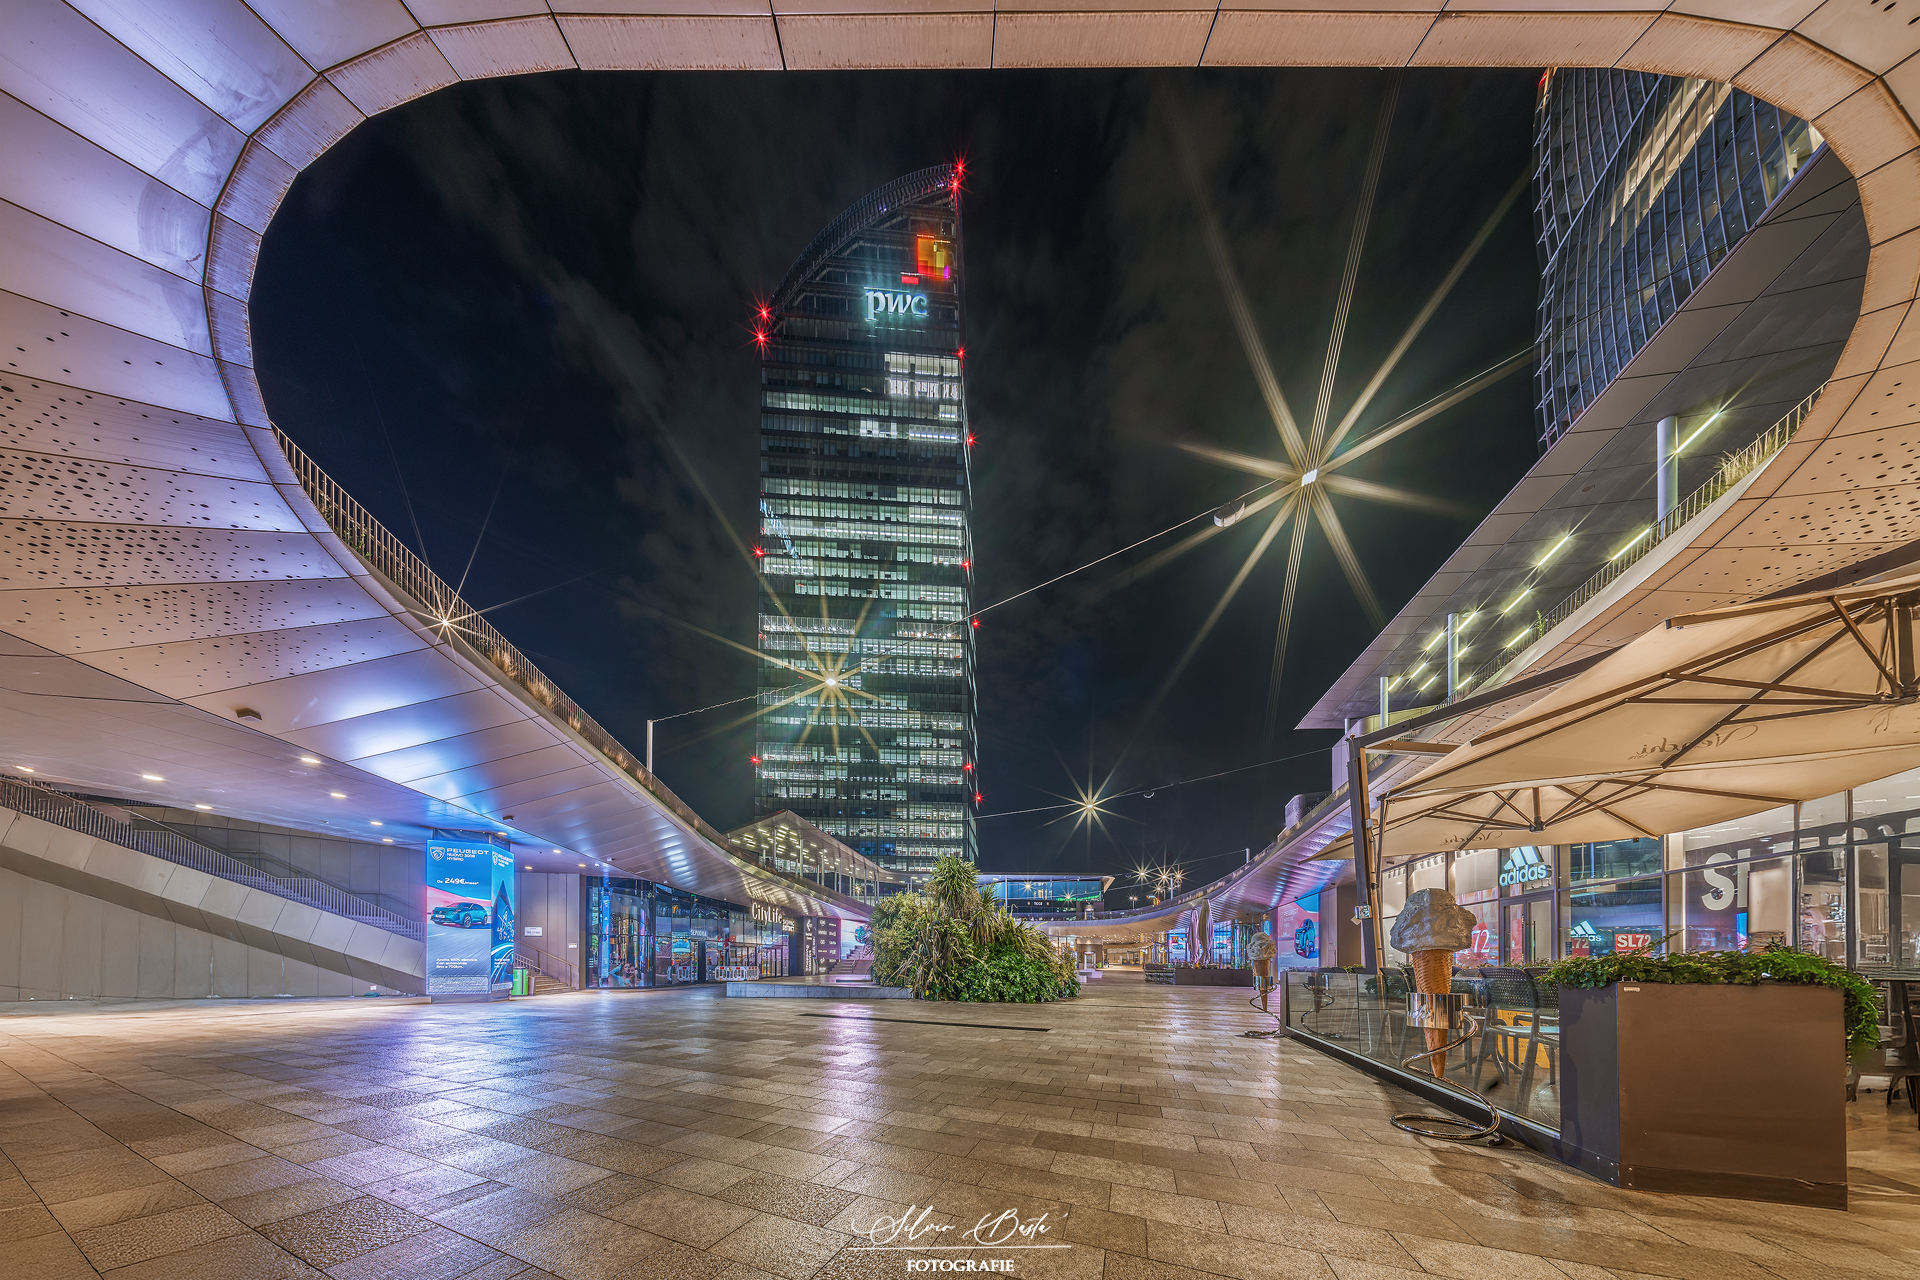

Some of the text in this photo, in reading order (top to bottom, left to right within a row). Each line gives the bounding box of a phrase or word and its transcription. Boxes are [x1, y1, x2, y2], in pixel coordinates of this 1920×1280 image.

[865, 290, 929, 322] pwc
[446, 847, 490, 855] PEUGEOT
[1499, 864, 1548, 887] adidas
[751, 902, 783, 926] CityLife
[1572, 938, 1590, 949] 72
[1617, 934, 1651, 948] SL72
